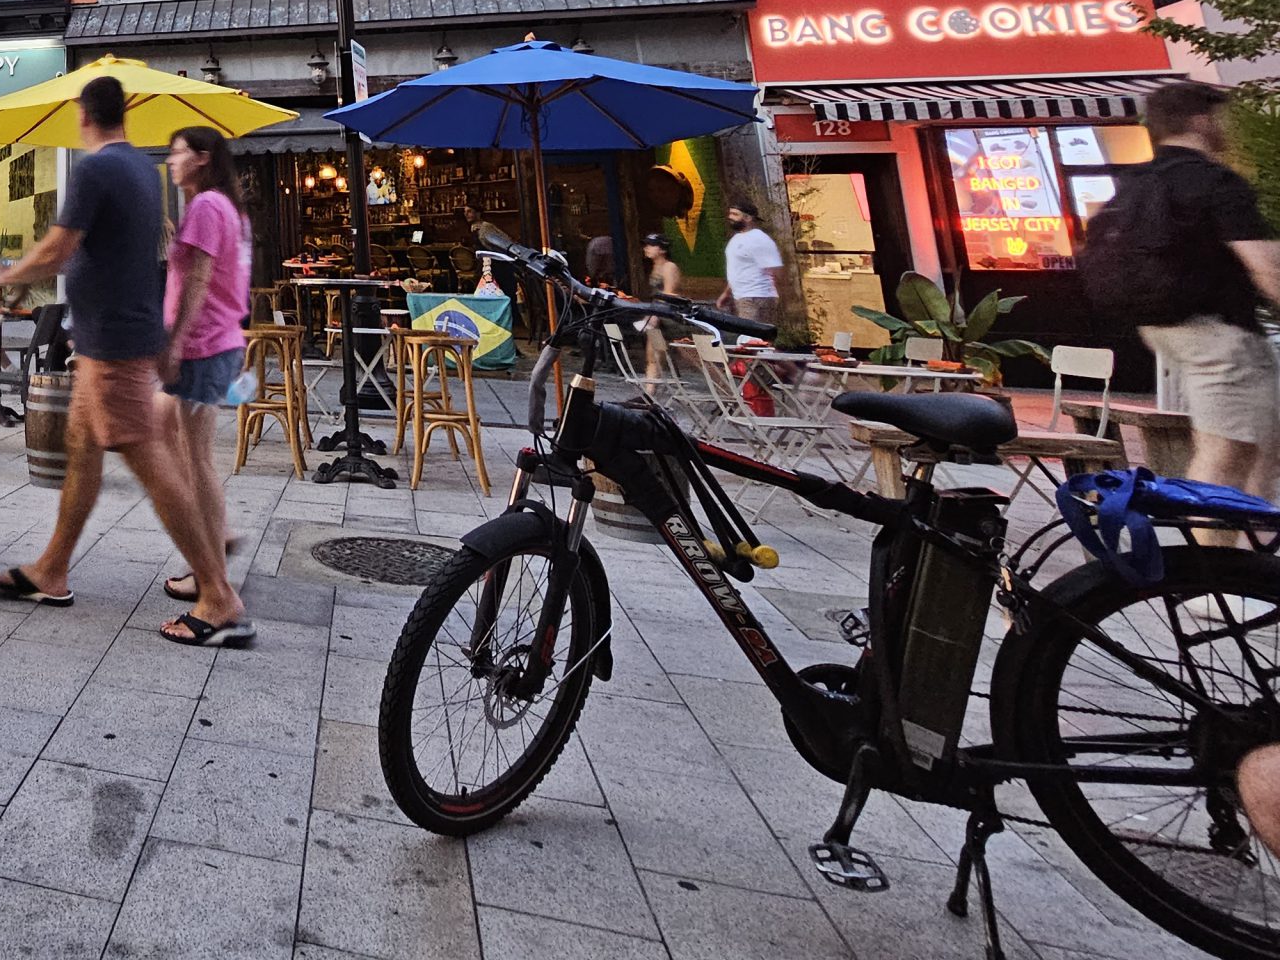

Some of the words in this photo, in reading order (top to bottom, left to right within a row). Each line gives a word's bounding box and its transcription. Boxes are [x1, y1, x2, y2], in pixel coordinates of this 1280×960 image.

[767, 13, 888, 43] BANG
[915, 1, 1139, 36] COOKIES
[812, 119, 852, 136] 128
[978, 155, 985, 169] I
[987, 154, 1022, 170] GOT
[970, 176, 1040, 191] BANGED
[1002, 196, 1020, 211] IN
[963, 217, 1019, 231] JERSEY
[1024, 217, 1061, 231] CITY
[1042, 256, 1073, 268] OPEN
